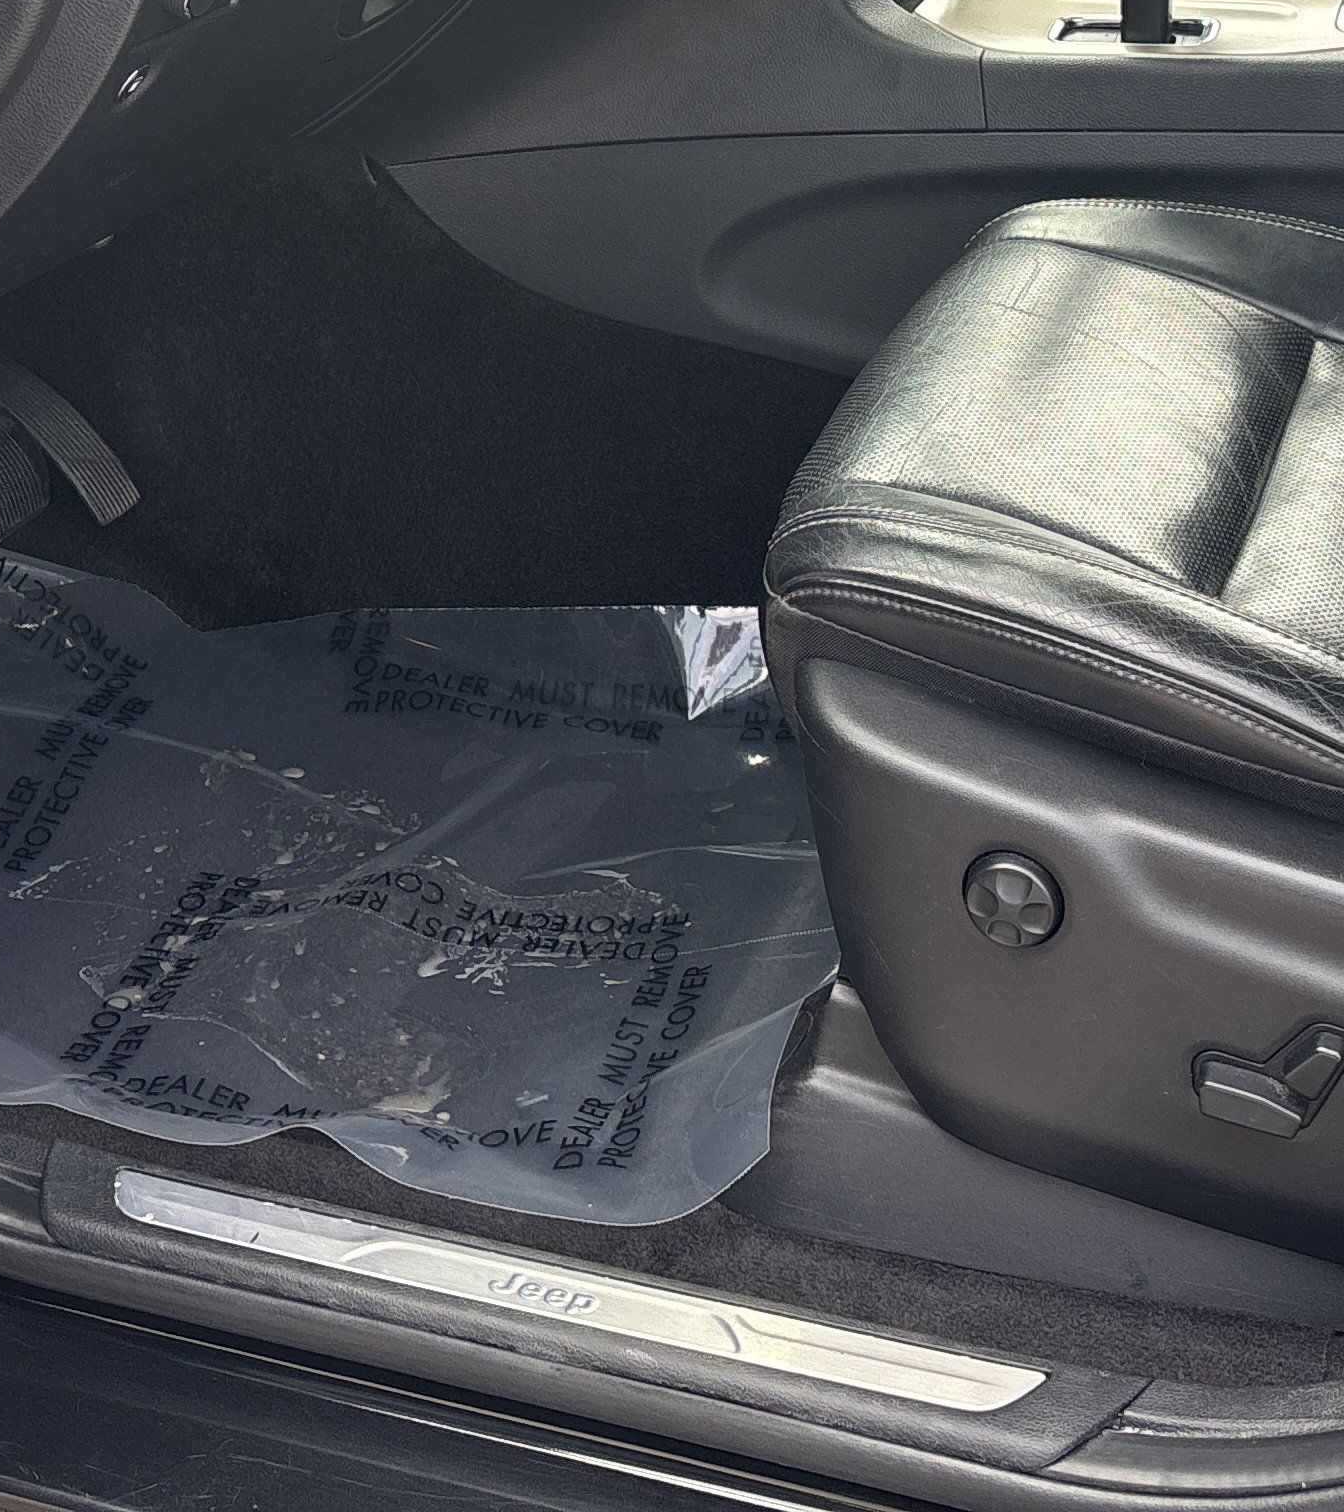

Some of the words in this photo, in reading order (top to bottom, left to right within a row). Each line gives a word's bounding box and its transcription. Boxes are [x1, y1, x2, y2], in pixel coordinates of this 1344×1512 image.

[380, 665, 490, 696] DEALER
[510, 681, 589, 709] MUST
[376, 690, 549, 730] PROTECTIVE
[563, 715, 663, 742] COVER
[3, 731, 109, 873] PROTECTIVE
[660, 964, 713, 1040] COVER
[553, 1096, 617, 1171] DEALER
[597, 1017, 649, 1086] MUST
[631, 912, 690, 1008] REMOVE
[121, 1074, 251, 1111] DEALER
[488, 1273, 599, 1314] Jeep
